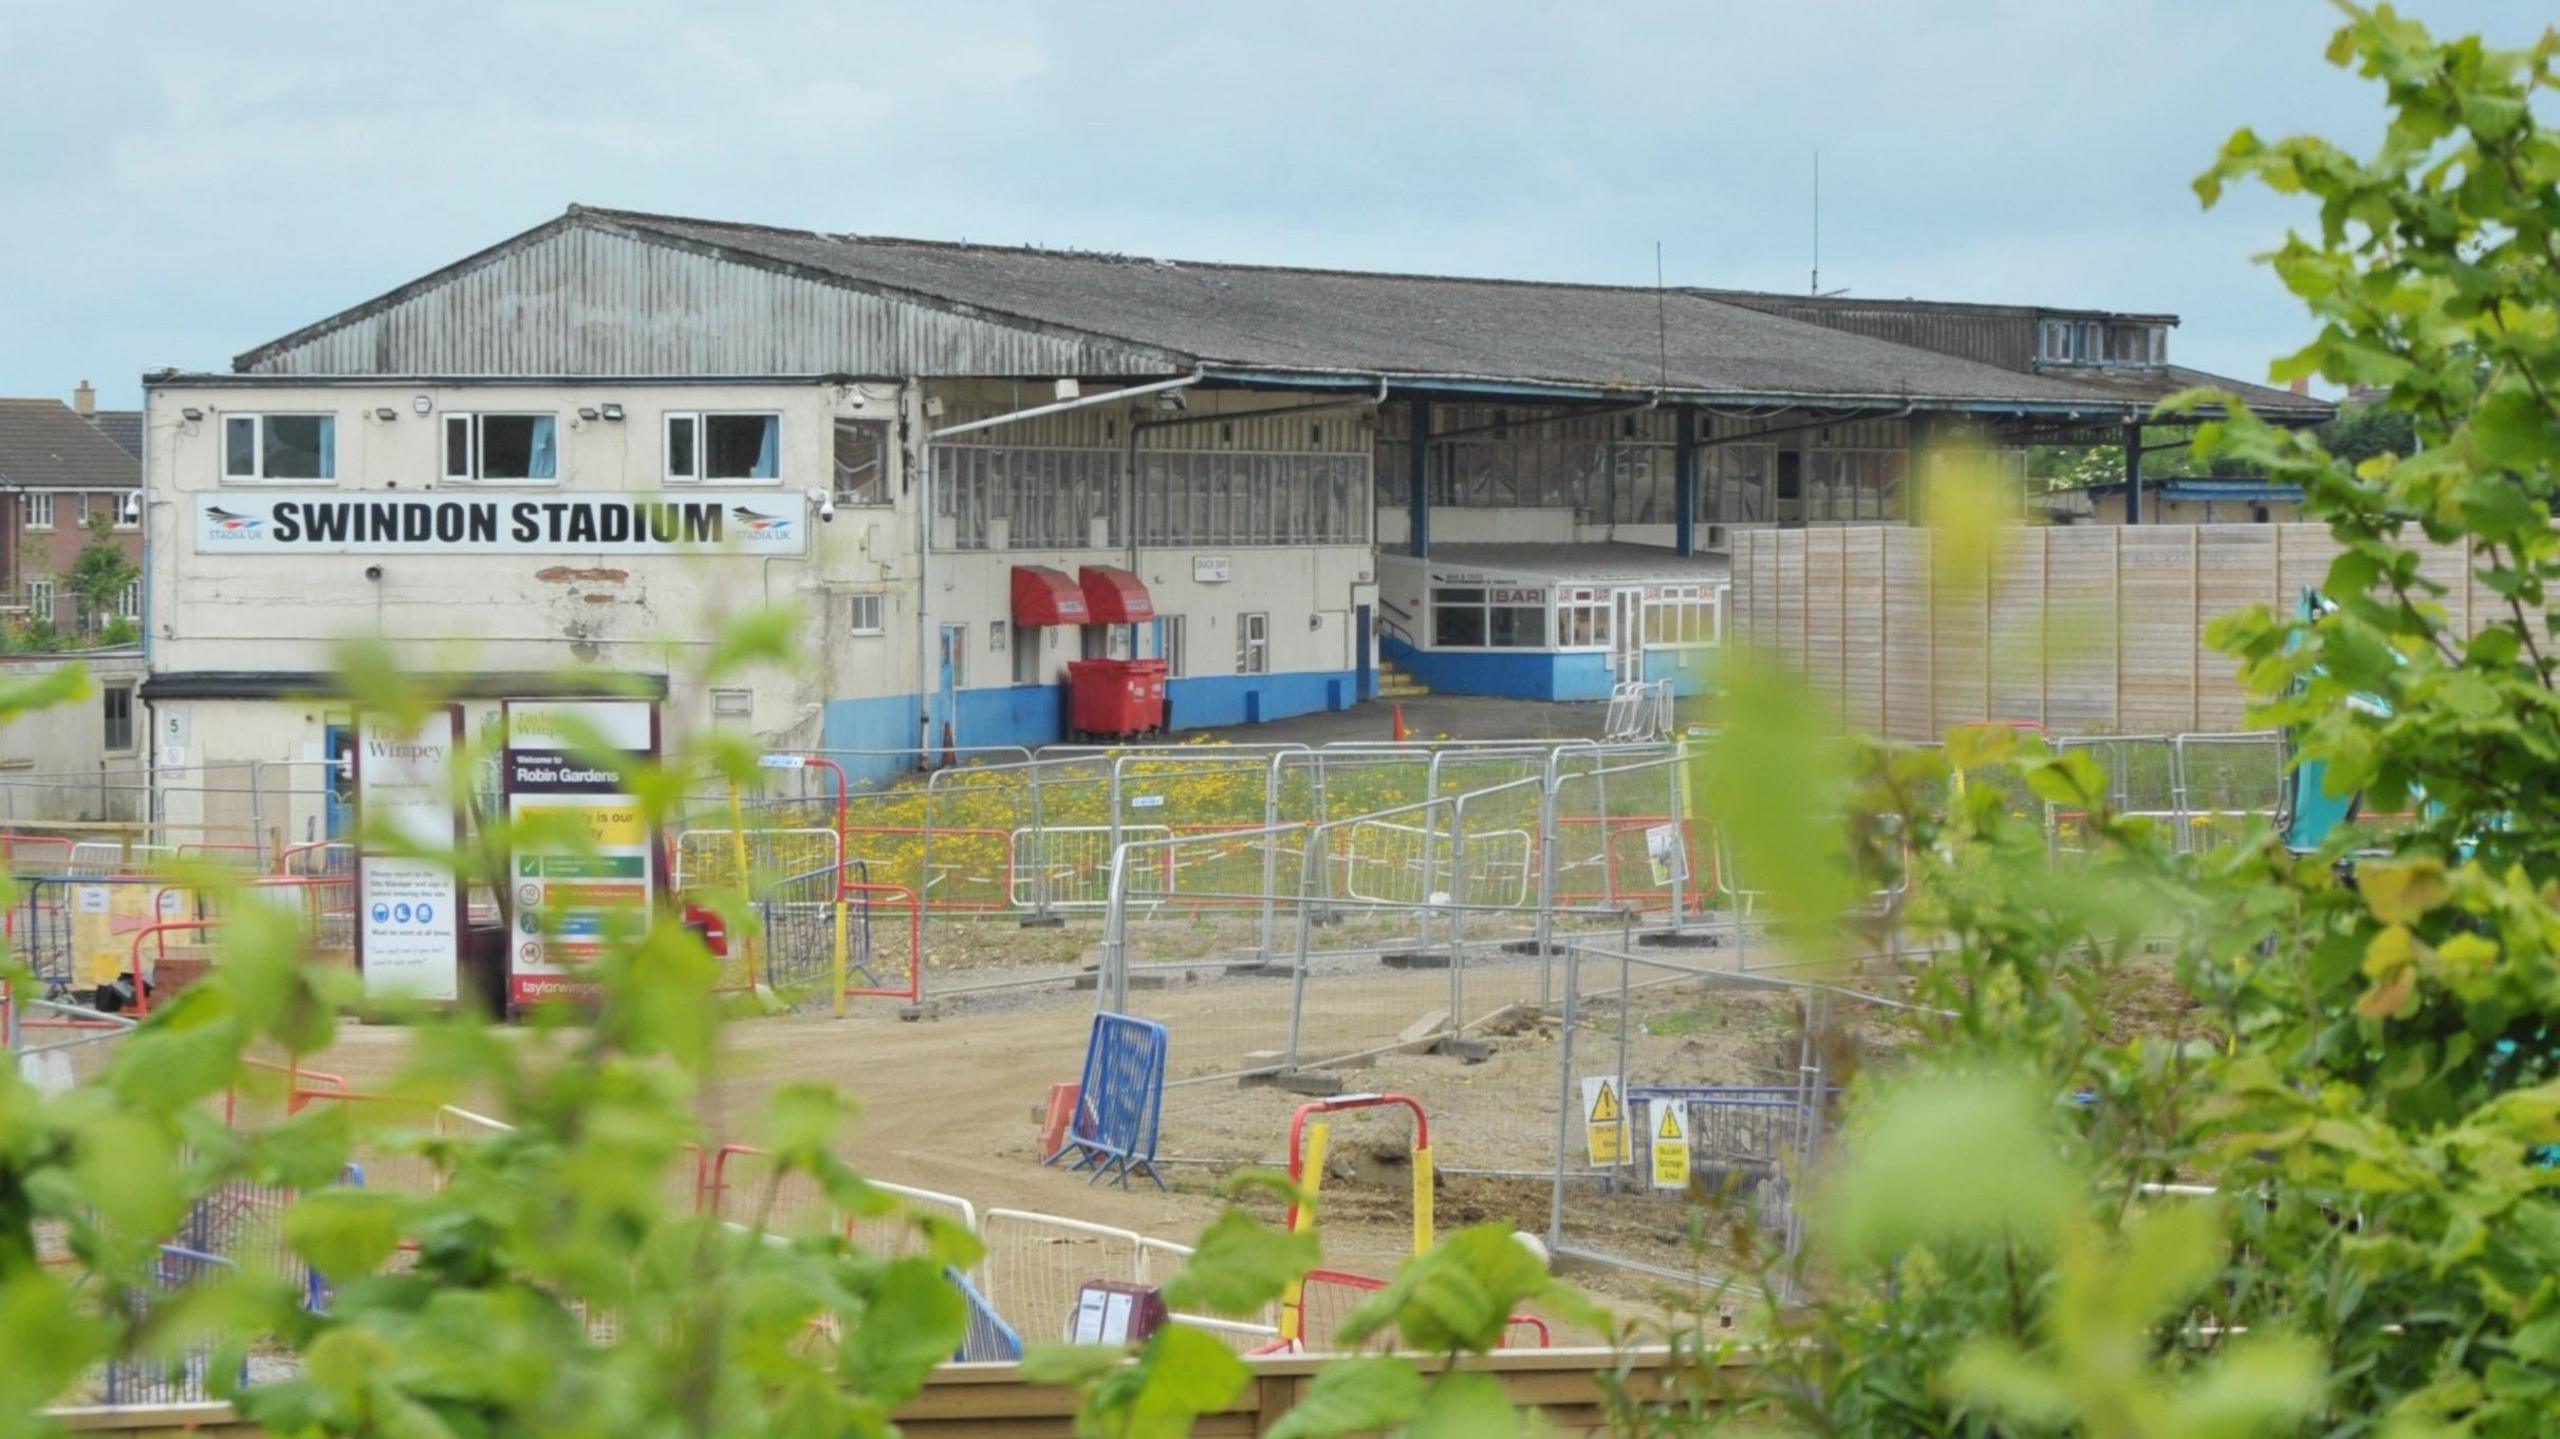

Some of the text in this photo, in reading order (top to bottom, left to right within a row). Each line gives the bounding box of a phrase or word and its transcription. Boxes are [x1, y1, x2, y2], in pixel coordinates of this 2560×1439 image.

[273, 502, 723, 543] SWINDON STADIUM
[209, 530, 263, 540] STADIA UK
[735, 530, 791, 540] STADIA UK
[1494, 590, 1540, 603] BAR
[169, 718, 179, 734] 5
[368, 741, 444, 764] Wimpey
[516, 755, 562, 764] Welcome to
[517, 767, 619, 783] Robin Gardens
[612, 813, 634, 823] our
